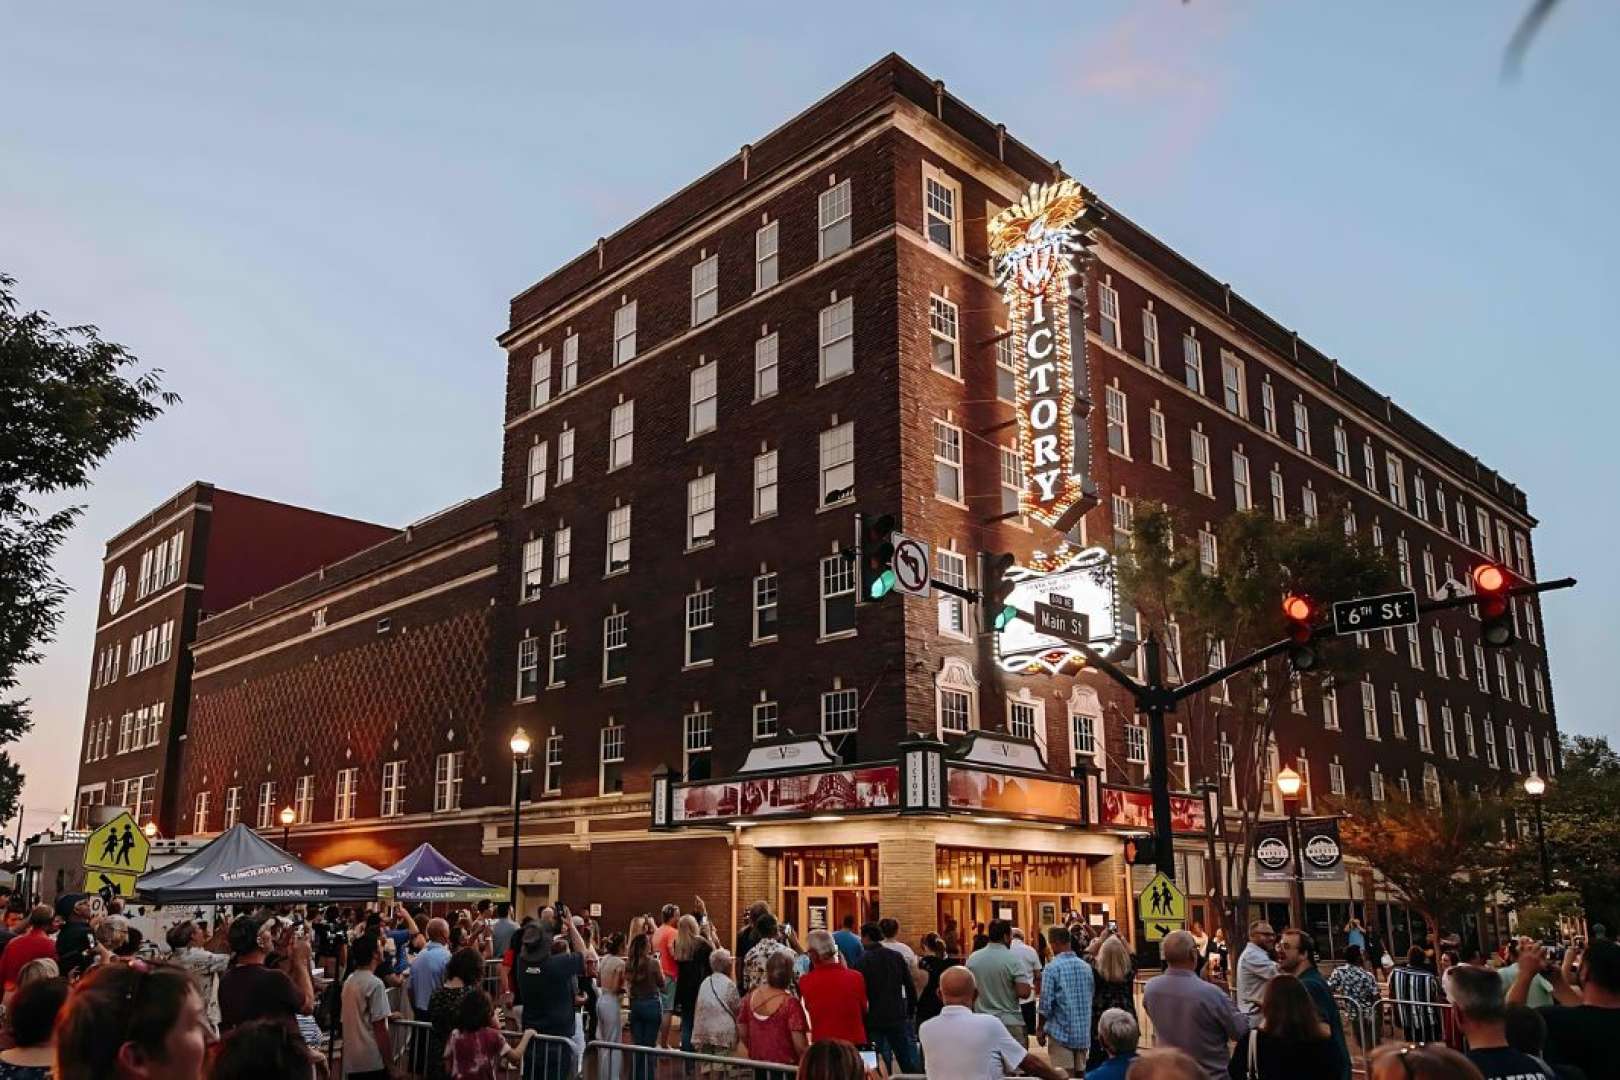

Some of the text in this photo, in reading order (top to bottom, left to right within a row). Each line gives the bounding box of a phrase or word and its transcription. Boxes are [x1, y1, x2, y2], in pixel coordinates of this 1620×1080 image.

[1041, 610, 1082, 636] Main St
[1348, 602, 1404, 625] 6TH St
